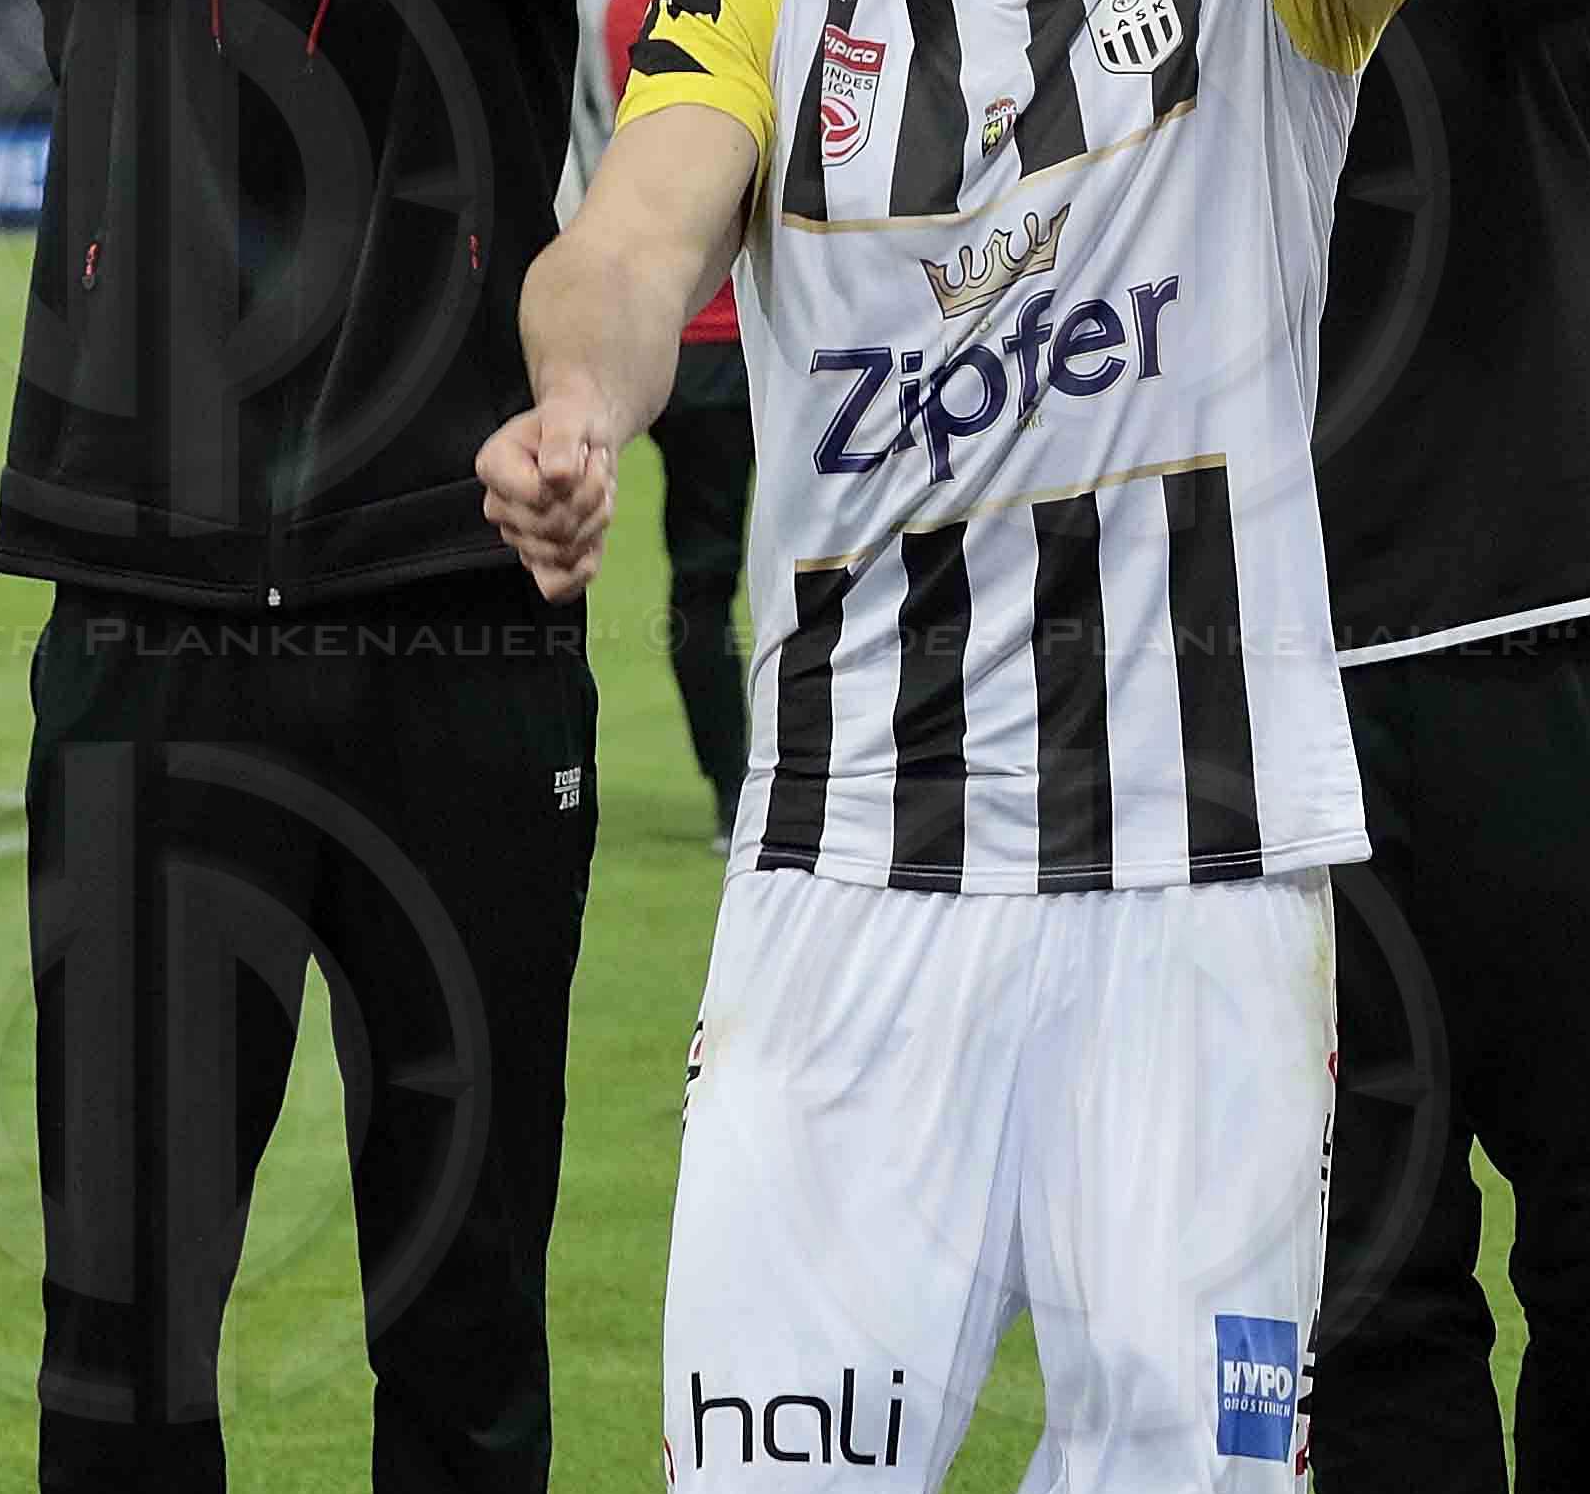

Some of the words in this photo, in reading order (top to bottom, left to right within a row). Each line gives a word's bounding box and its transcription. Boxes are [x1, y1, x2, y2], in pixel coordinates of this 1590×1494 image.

[1098, 0, 1167, 39] LASK
[810, 274, 1181, 486] Zipfer
[1223, 1360, 1293, 1401] HYPO
[691, 1368, 905, 1470] hali
